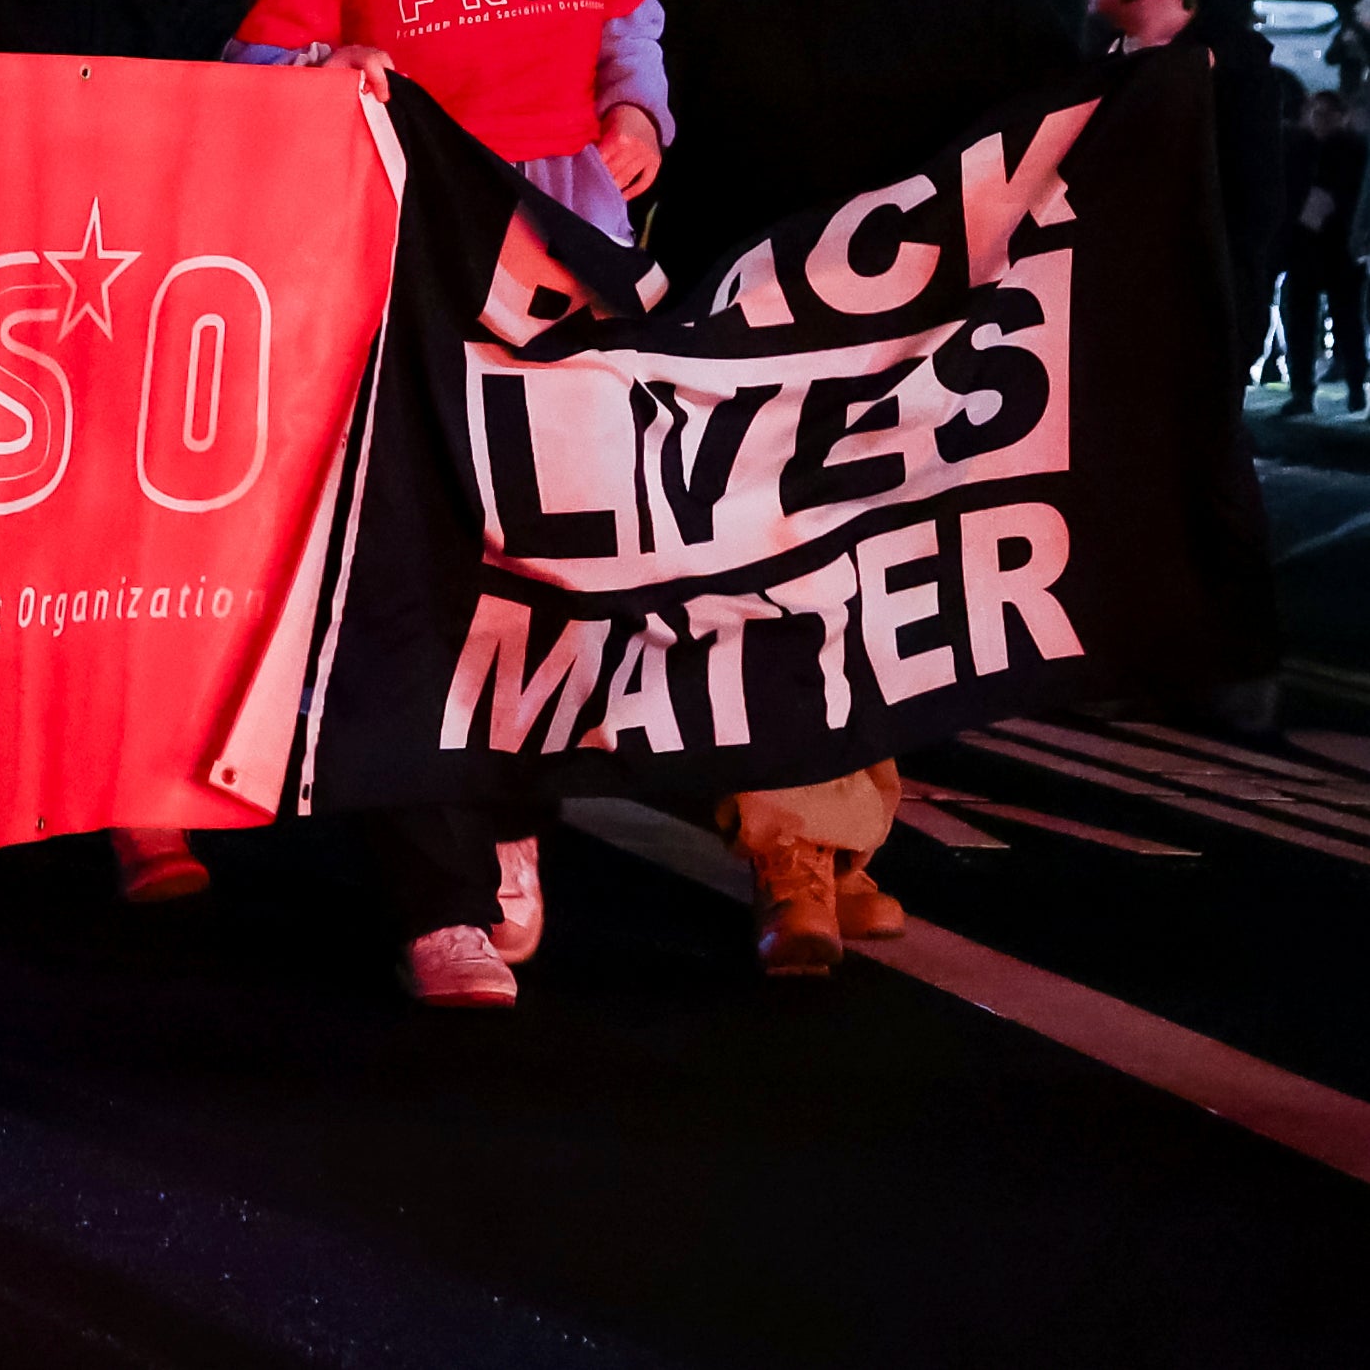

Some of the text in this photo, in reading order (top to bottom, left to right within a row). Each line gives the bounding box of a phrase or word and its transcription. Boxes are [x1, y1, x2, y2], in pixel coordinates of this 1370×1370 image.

[458, 12, 490, 26] Road
[481, 285, 1051, 558] LIVES
[17, 575, 266, 638] Organization
[439, 502, 1084, 754] MATTER
